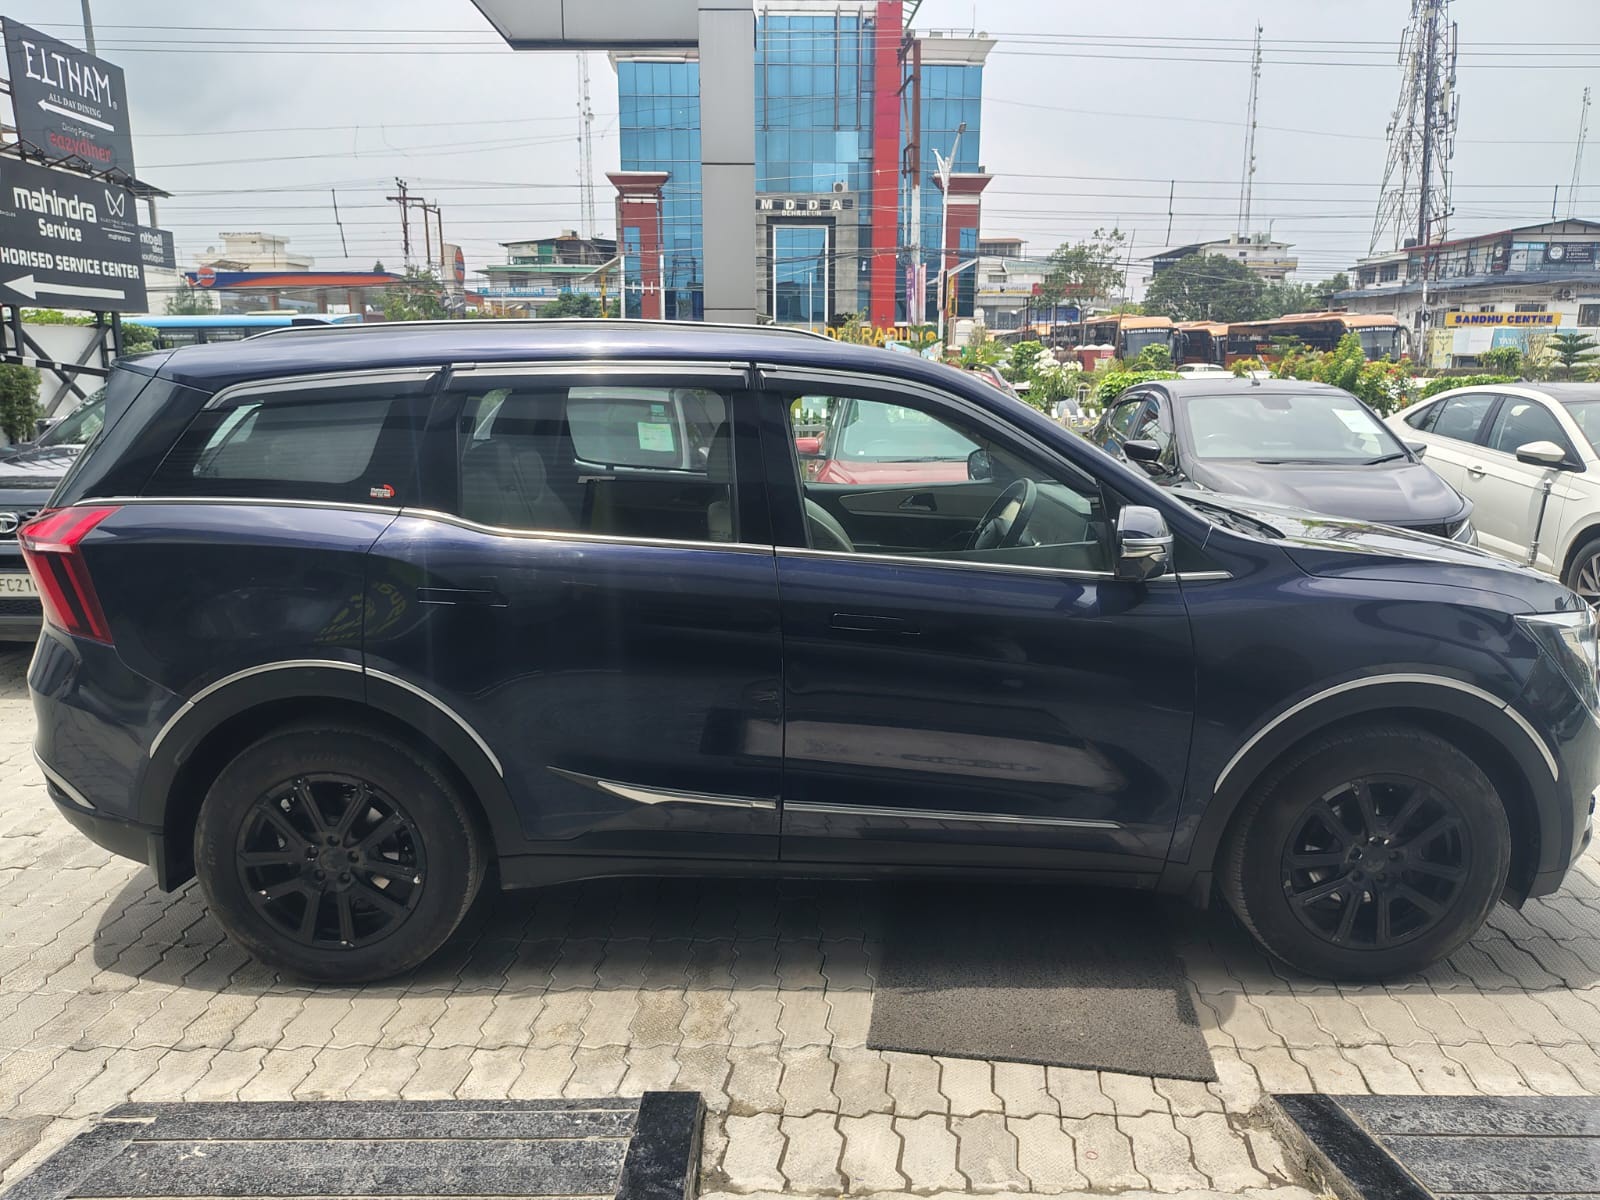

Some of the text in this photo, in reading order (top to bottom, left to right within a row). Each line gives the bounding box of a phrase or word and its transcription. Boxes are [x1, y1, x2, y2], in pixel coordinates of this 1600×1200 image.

[22, 40, 112, 108] ELTHAM
[48, 92, 102, 118] ALL DAY DINING
[13, 187, 97, 224] mahindra
[38, 218, 82, 242] Service
[0, 246, 140, 280] HORISED SERVICE CENTER
[1455, 314, 1554, 324] SANDHU CENTRE
